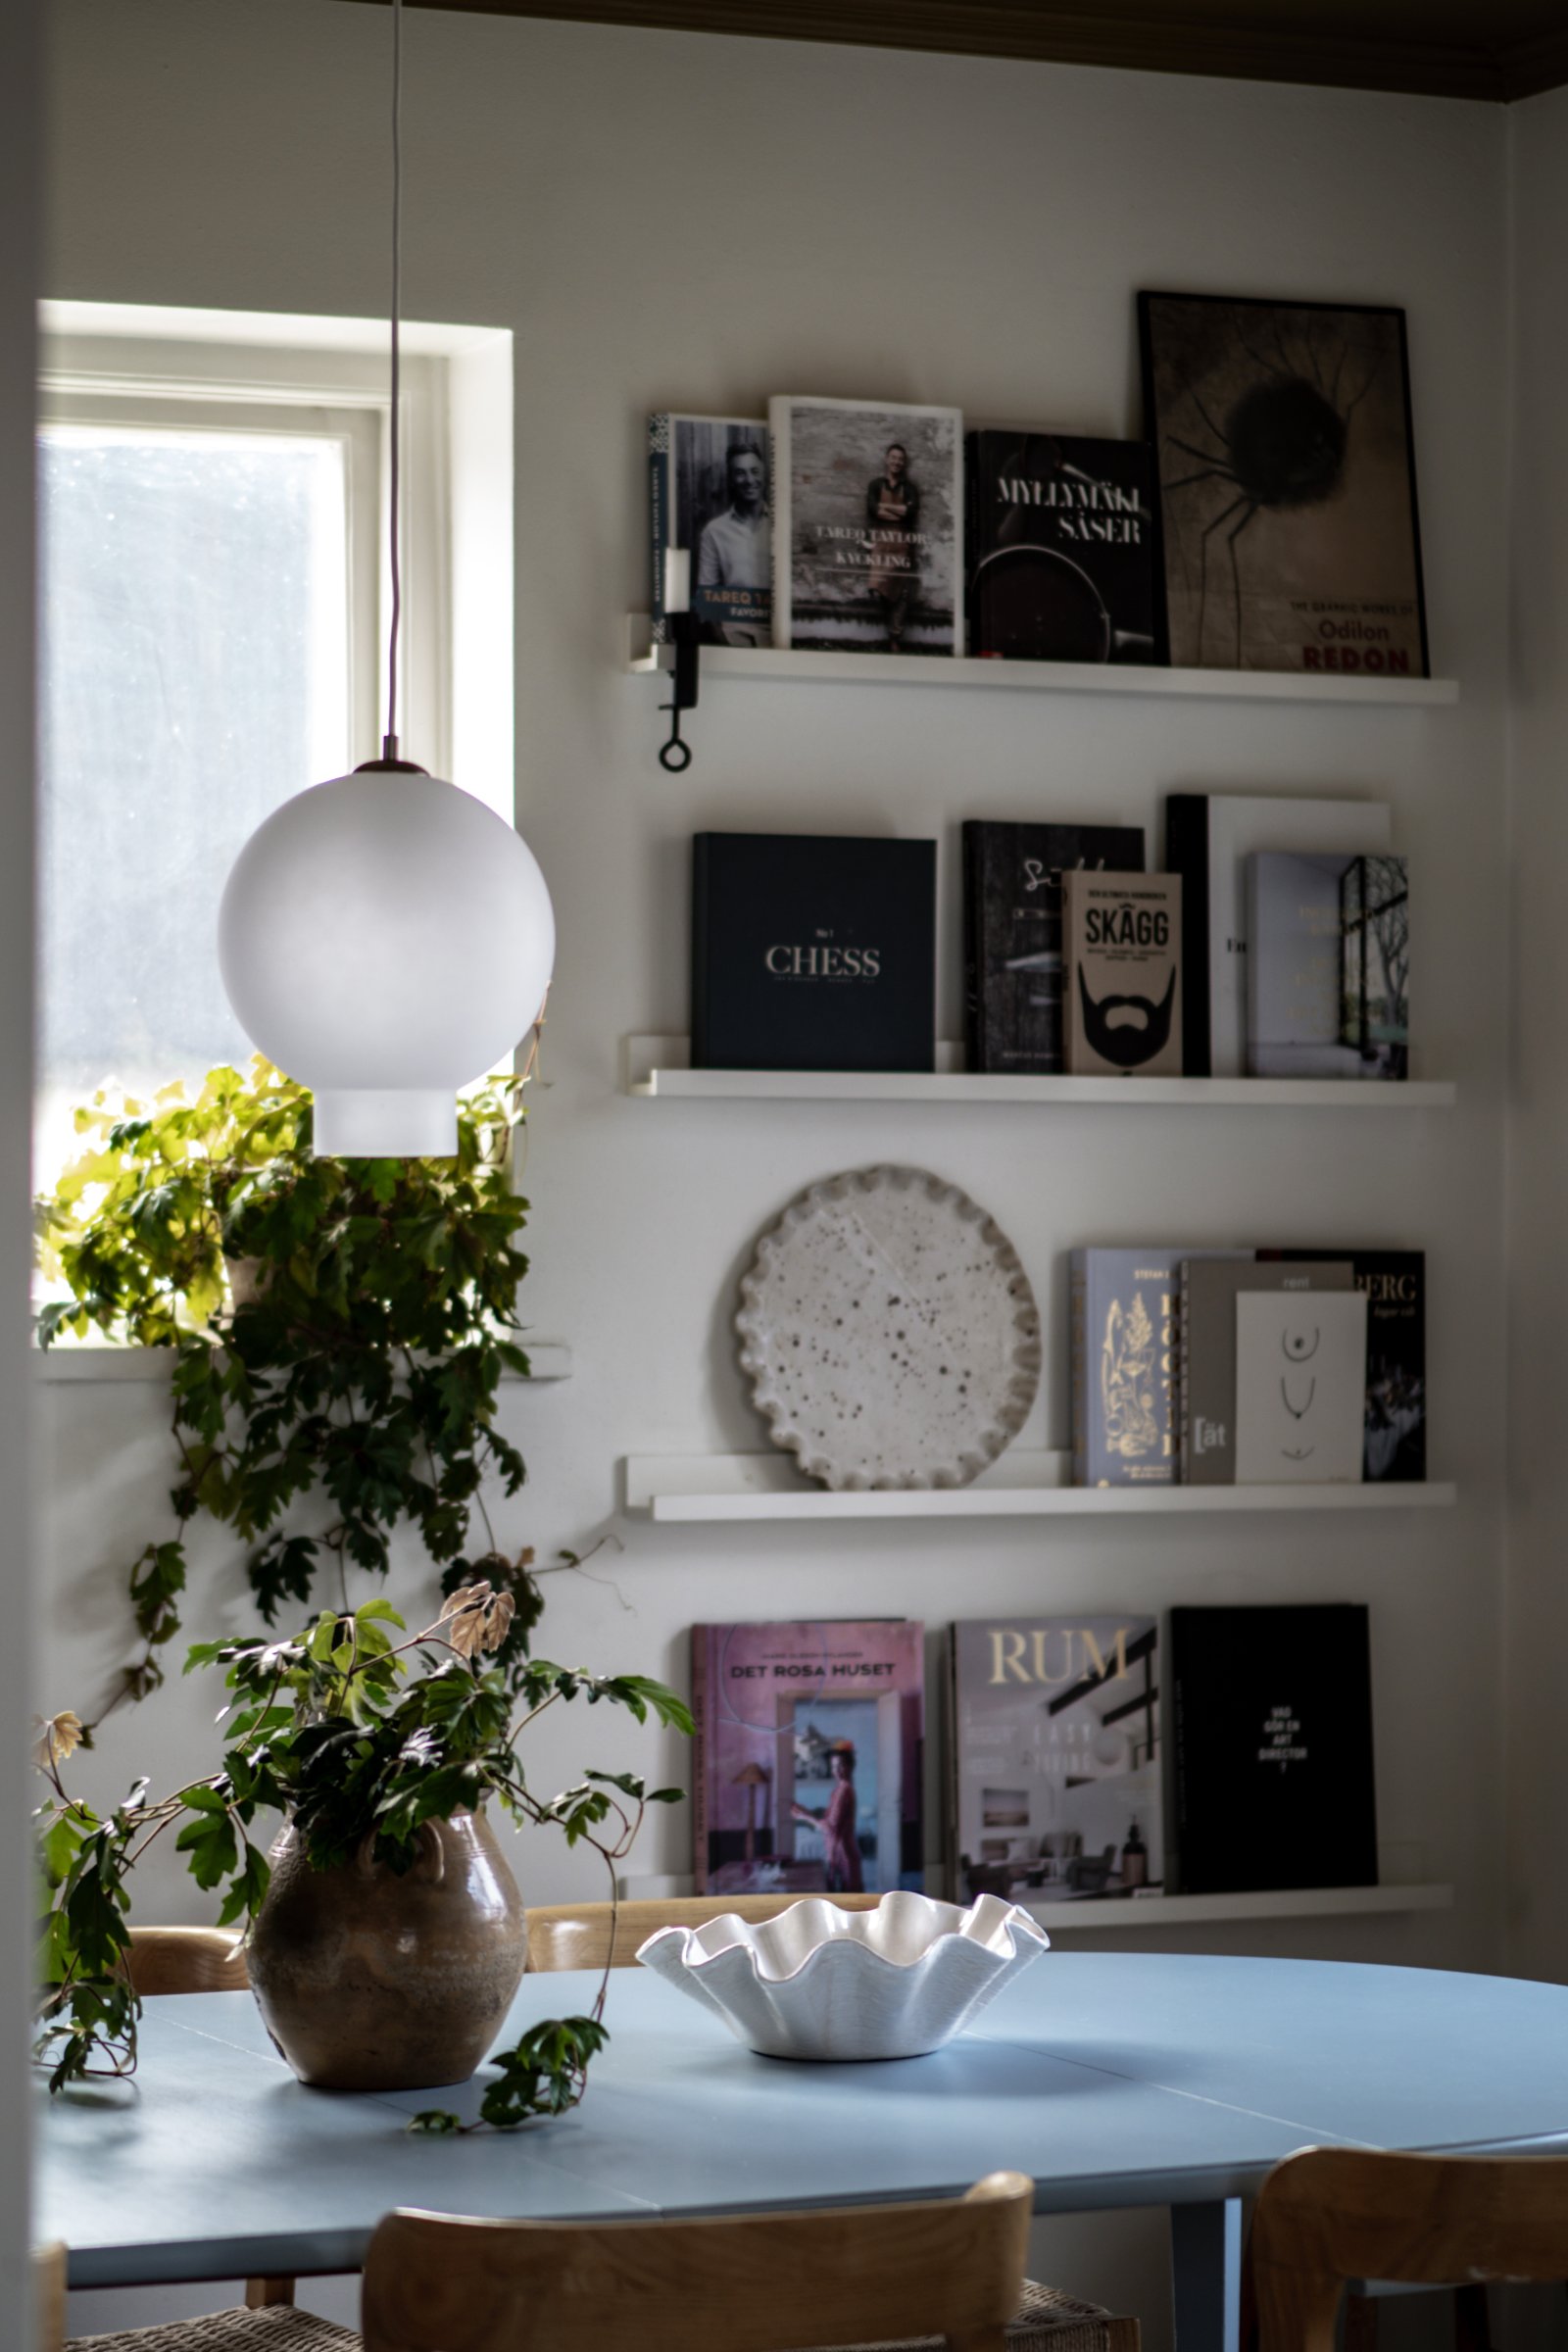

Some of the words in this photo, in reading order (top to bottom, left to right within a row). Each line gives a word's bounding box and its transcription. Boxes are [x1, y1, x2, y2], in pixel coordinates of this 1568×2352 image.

[997, 477, 1141, 514] MYLLYMÄKI
[815, 525, 873, 546] TAREQ
[870, 530, 927, 545] TAYLOR
[1058, 513, 1141, 544] SÅSER
[835, 551, 911, 568] KYCKLING
[704, 589, 752, 605] TAREQ
[1319, 618, 1389, 640] Odilon
[1302, 646, 1409, 673] REDON
[764, 946, 880, 977] CHESS
[988, 1628, 1132, 1685] RUM
[730, 1665, 768, 1679] DET
[774, 1664, 826, 1678] ROSA
[832, 1663, 897, 1677] HUSET
